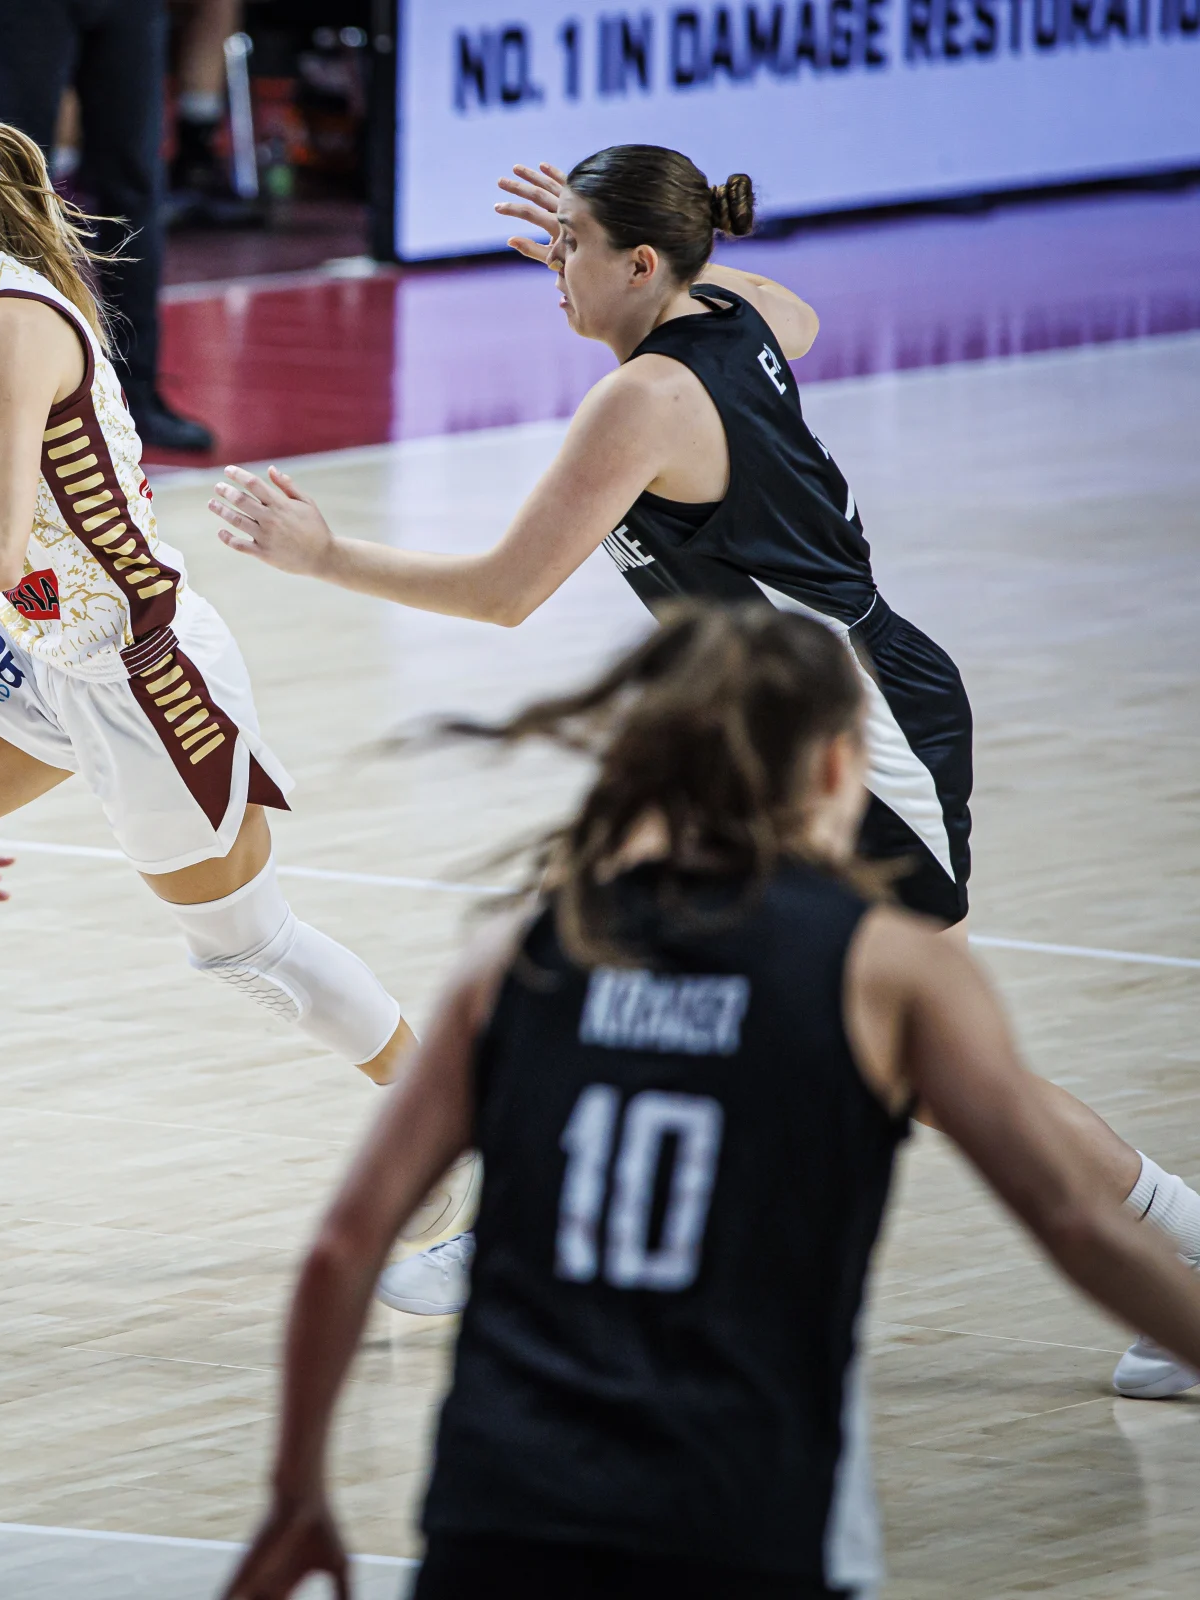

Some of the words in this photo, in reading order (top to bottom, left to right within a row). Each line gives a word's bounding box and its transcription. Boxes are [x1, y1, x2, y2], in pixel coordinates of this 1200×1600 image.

[455, 24, 543, 111] NO.
[560, 18, 580, 101] 1
[598, 13, 652, 96] IN
[669, 0, 886, 90] DAMAGE
[554, 1082, 725, 1291] 10
